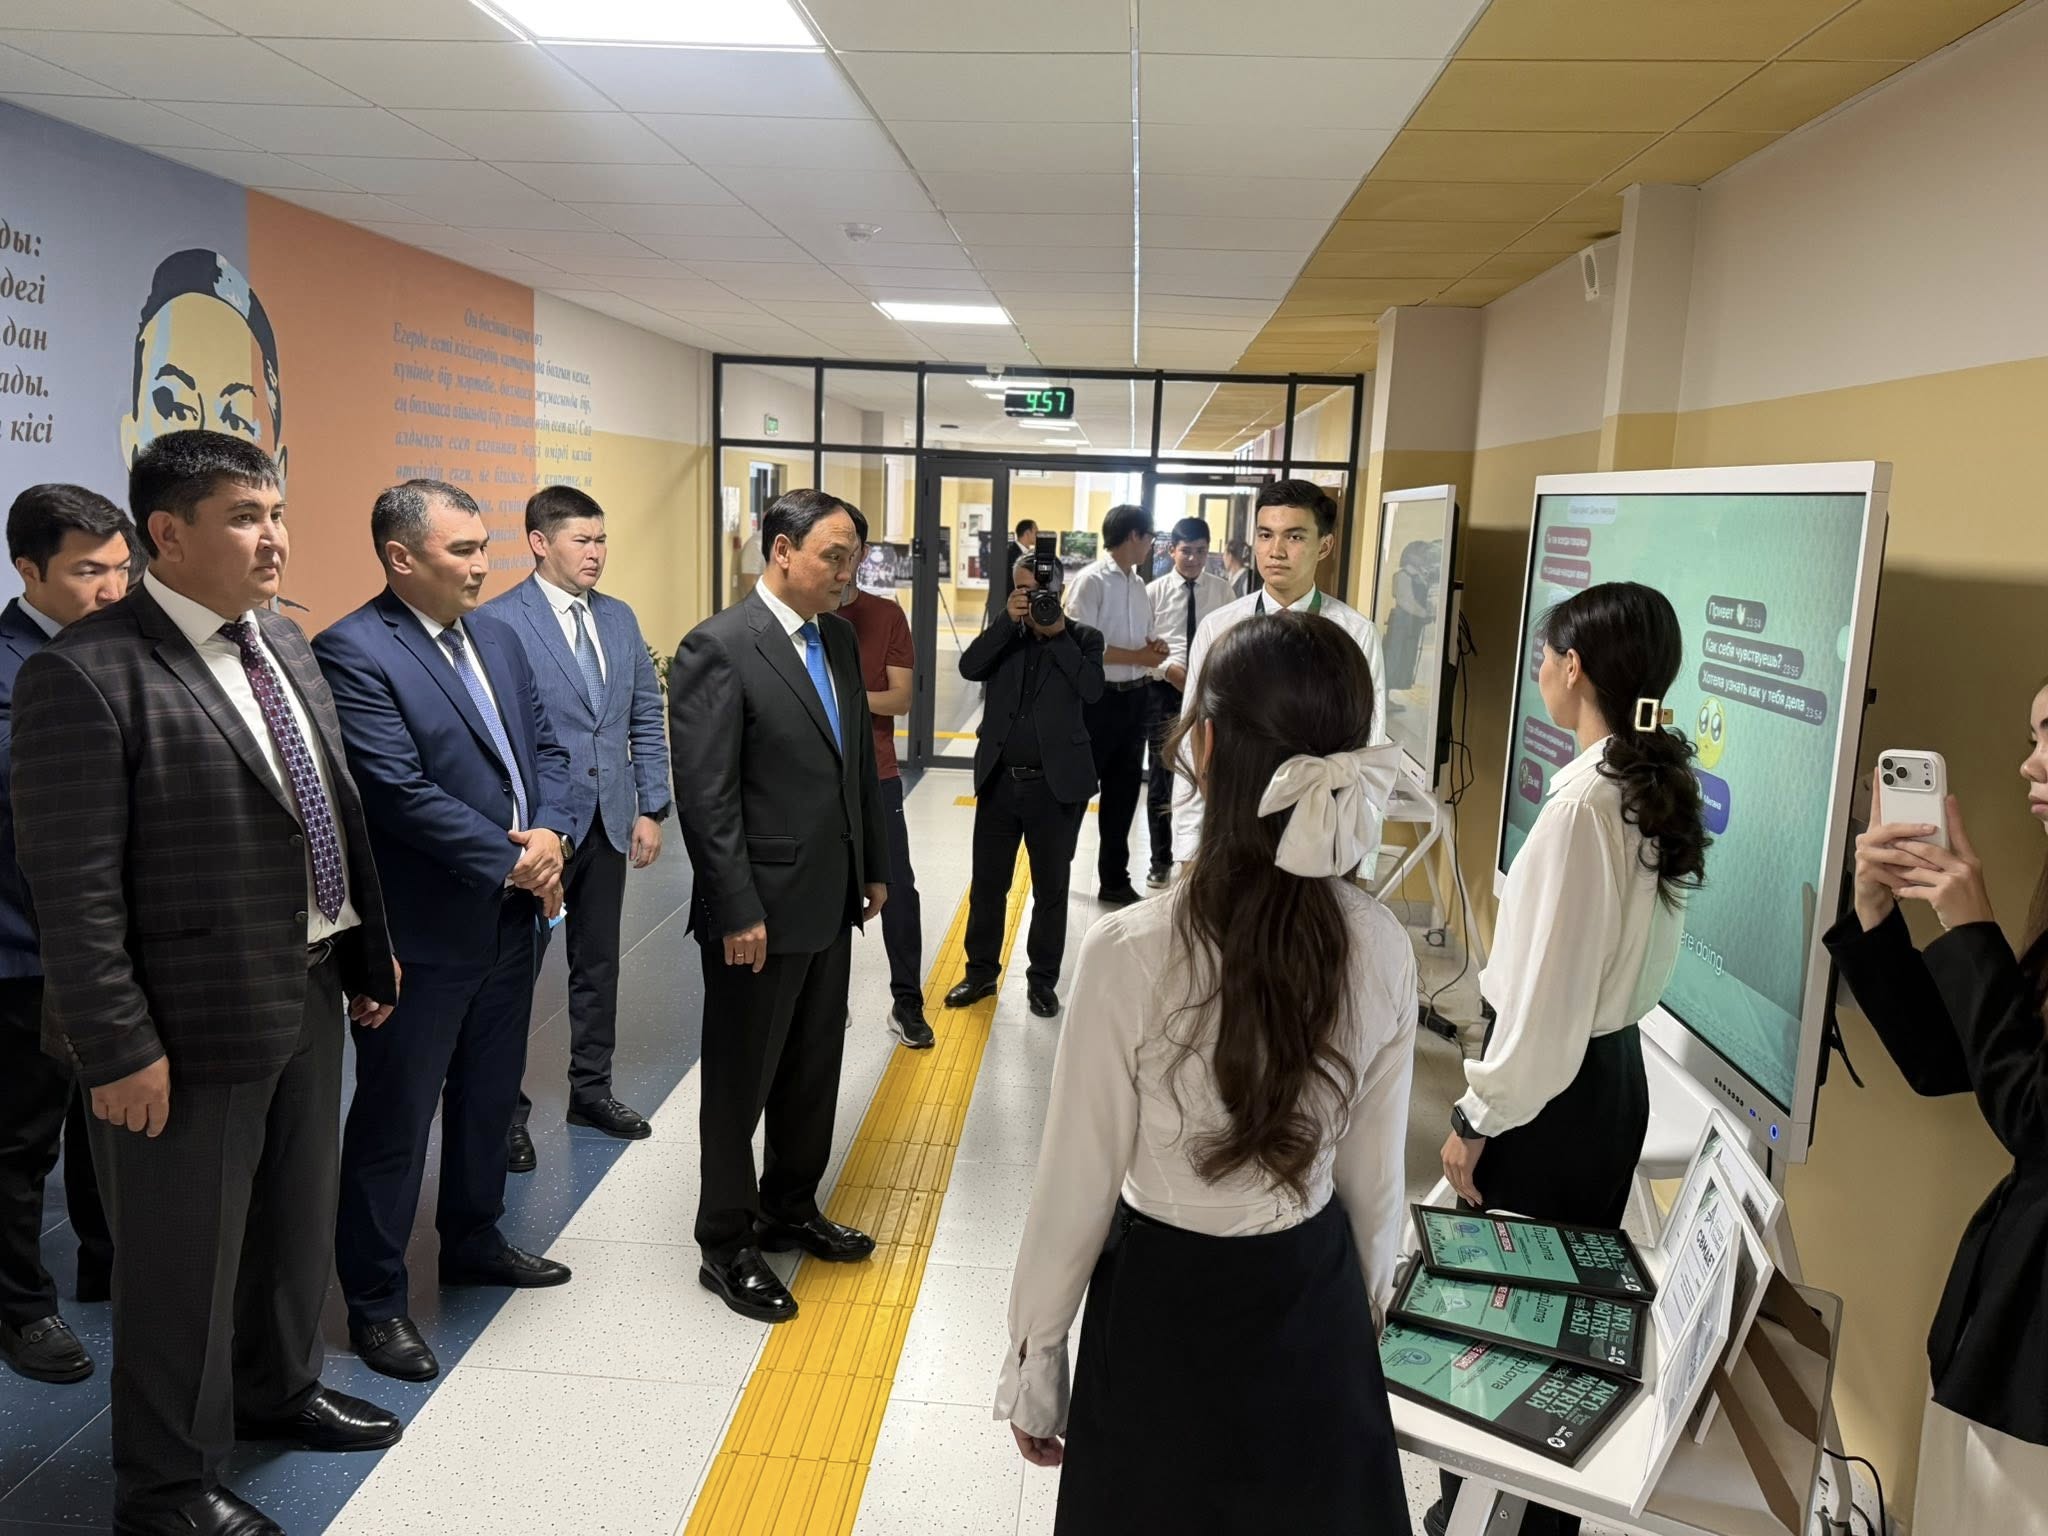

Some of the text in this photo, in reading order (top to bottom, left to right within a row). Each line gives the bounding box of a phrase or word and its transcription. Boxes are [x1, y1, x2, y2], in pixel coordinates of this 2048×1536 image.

[0, 315, 48, 351] дан
[10, 412, 54, 443] кісі
[1708, 601, 1735, 620] Привет
[1705, 638, 1717, 653] Как
[1718, 641, 1735, 657] себя
[1736, 648, 1783, 668] чувствуешь?
[1702, 669, 1725, 688] Хотела
[1724, 677, 1748, 695] узнать
[1748, 685, 1761, 699] как
[1768, 689, 1785, 706] тебя
[1785, 695, 1806, 712] дела
[1696, 938, 1725, 976] doing.
[1531, 1227, 1554, 1261] Diploma
[1569, 1243, 1595, 1267] ASIA
[1696, 1229, 1715, 1267] СВИДЕ
[1533, 1292, 1553, 1323] iploma
[1569, 1308, 1591, 1335] ASIA
[1589, 1300, 1612, 1341] MATRIX
[1612, 1305, 1633, 1331] INFO
[1525, 1377, 1566, 1409] ASIA
[1545, 1372, 1600, 1418] MATRIX
[1580, 1380, 1619, 1411] INFO
